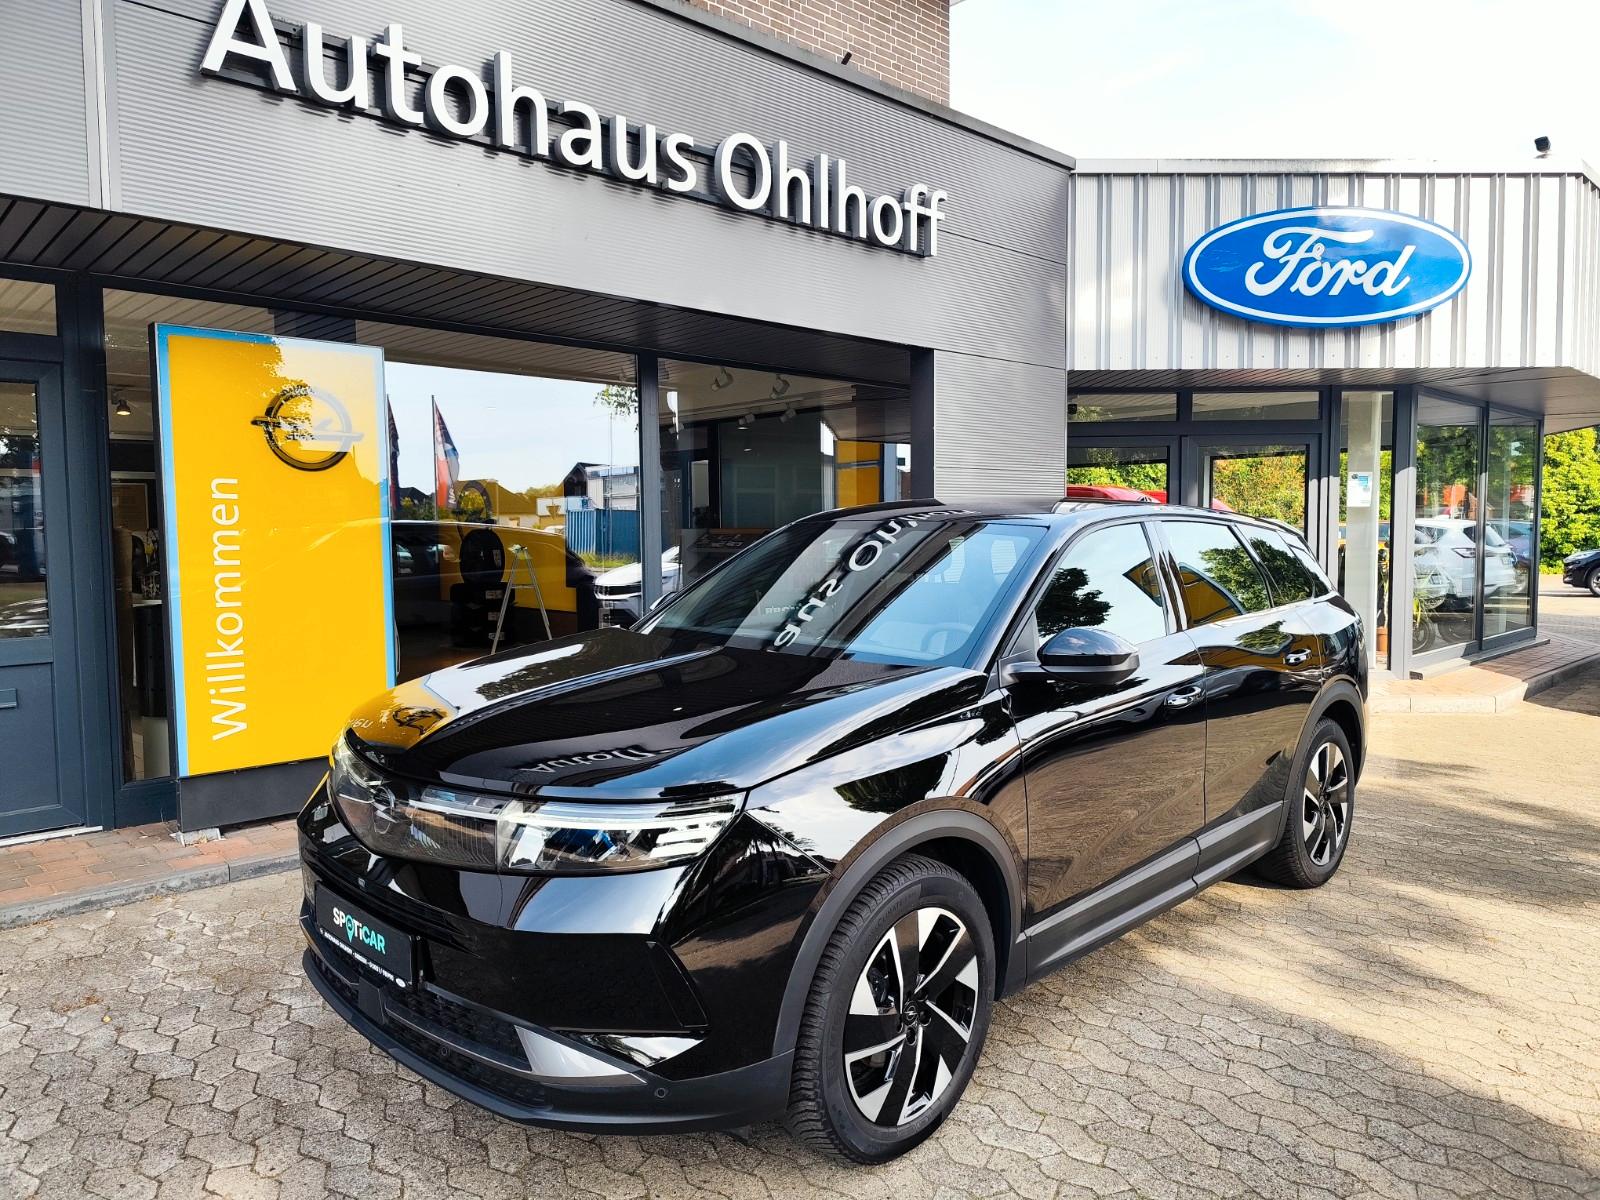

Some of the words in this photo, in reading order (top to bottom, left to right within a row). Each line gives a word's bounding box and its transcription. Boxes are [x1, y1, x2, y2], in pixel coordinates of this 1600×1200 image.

[200, 0, 698, 193] Autohaus
[713, 132, 949, 257] Ohlhoff
[1244, 226, 1417, 297] Ford
[204, 476, 248, 742] Willkommen
